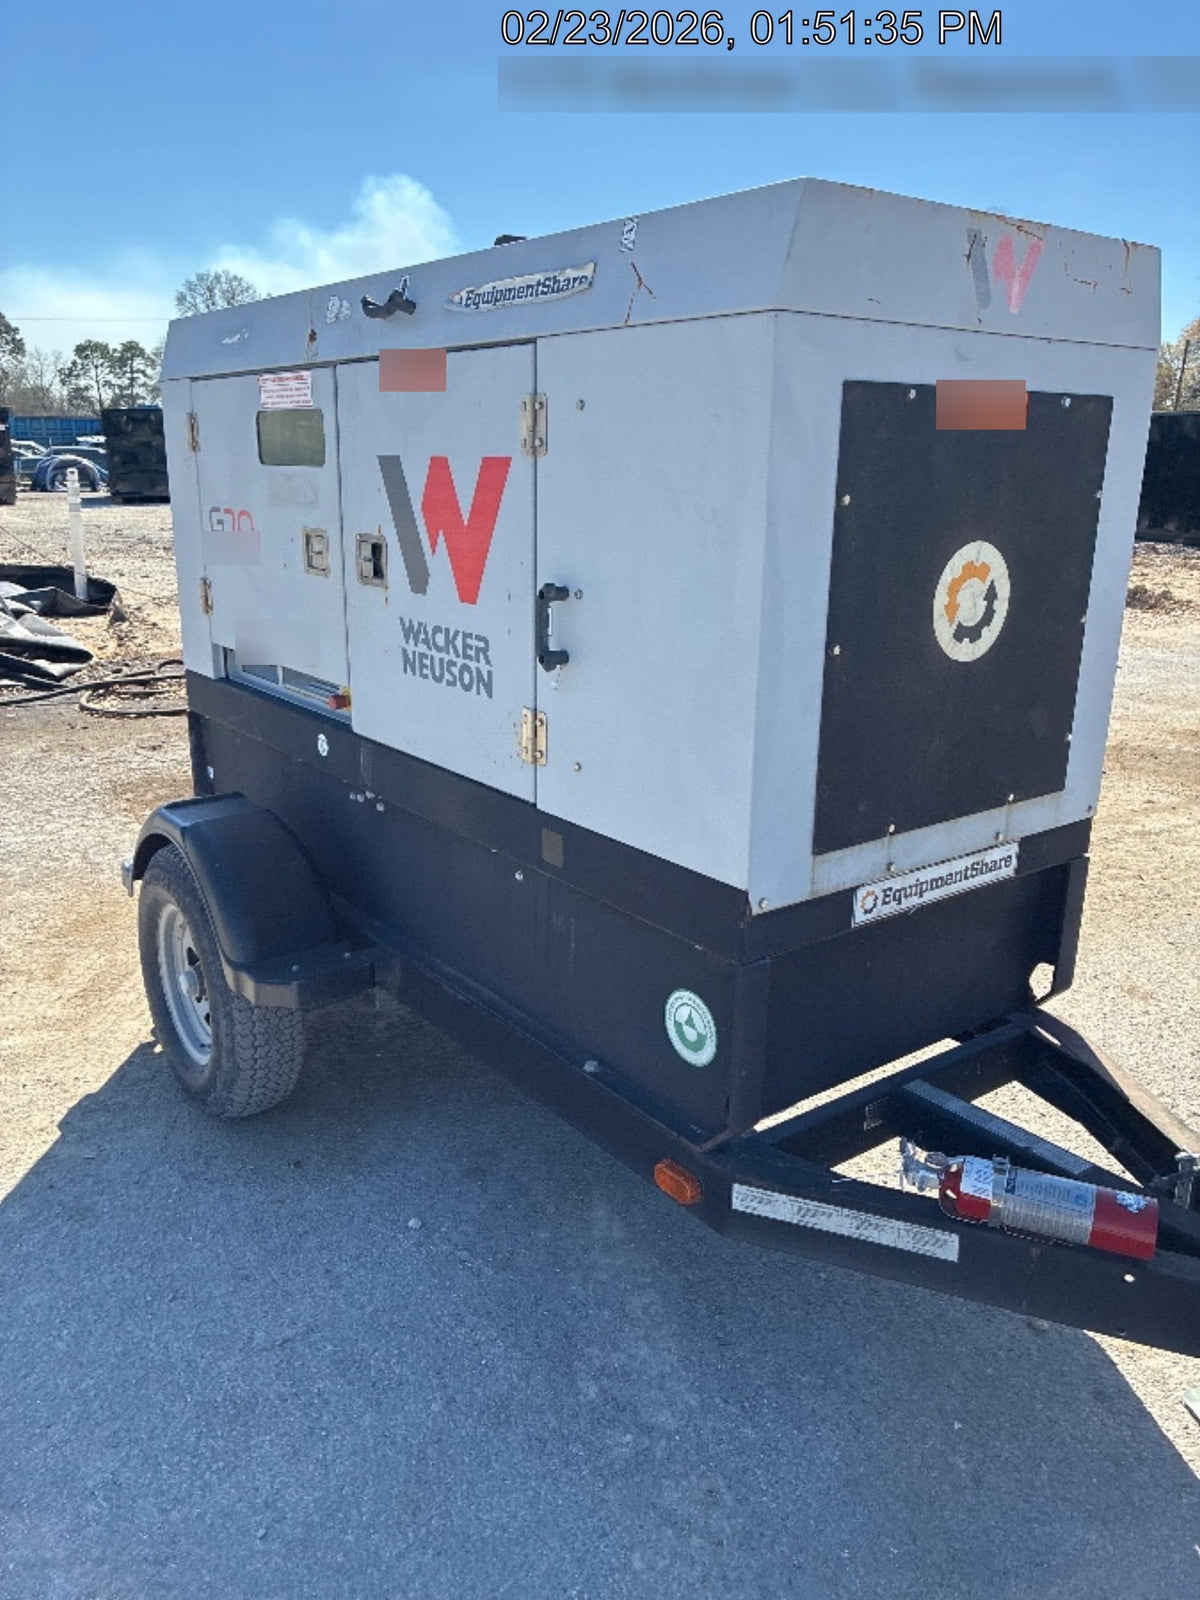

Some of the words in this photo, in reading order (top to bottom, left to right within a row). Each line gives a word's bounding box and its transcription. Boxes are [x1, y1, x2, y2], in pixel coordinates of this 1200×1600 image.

[464, 275, 589, 310] EquipmentShare
[398, 615, 494, 668] WACKER
[400, 646, 494, 699] NEUSON
[881, 853, 1013, 906] EquipmentShare
